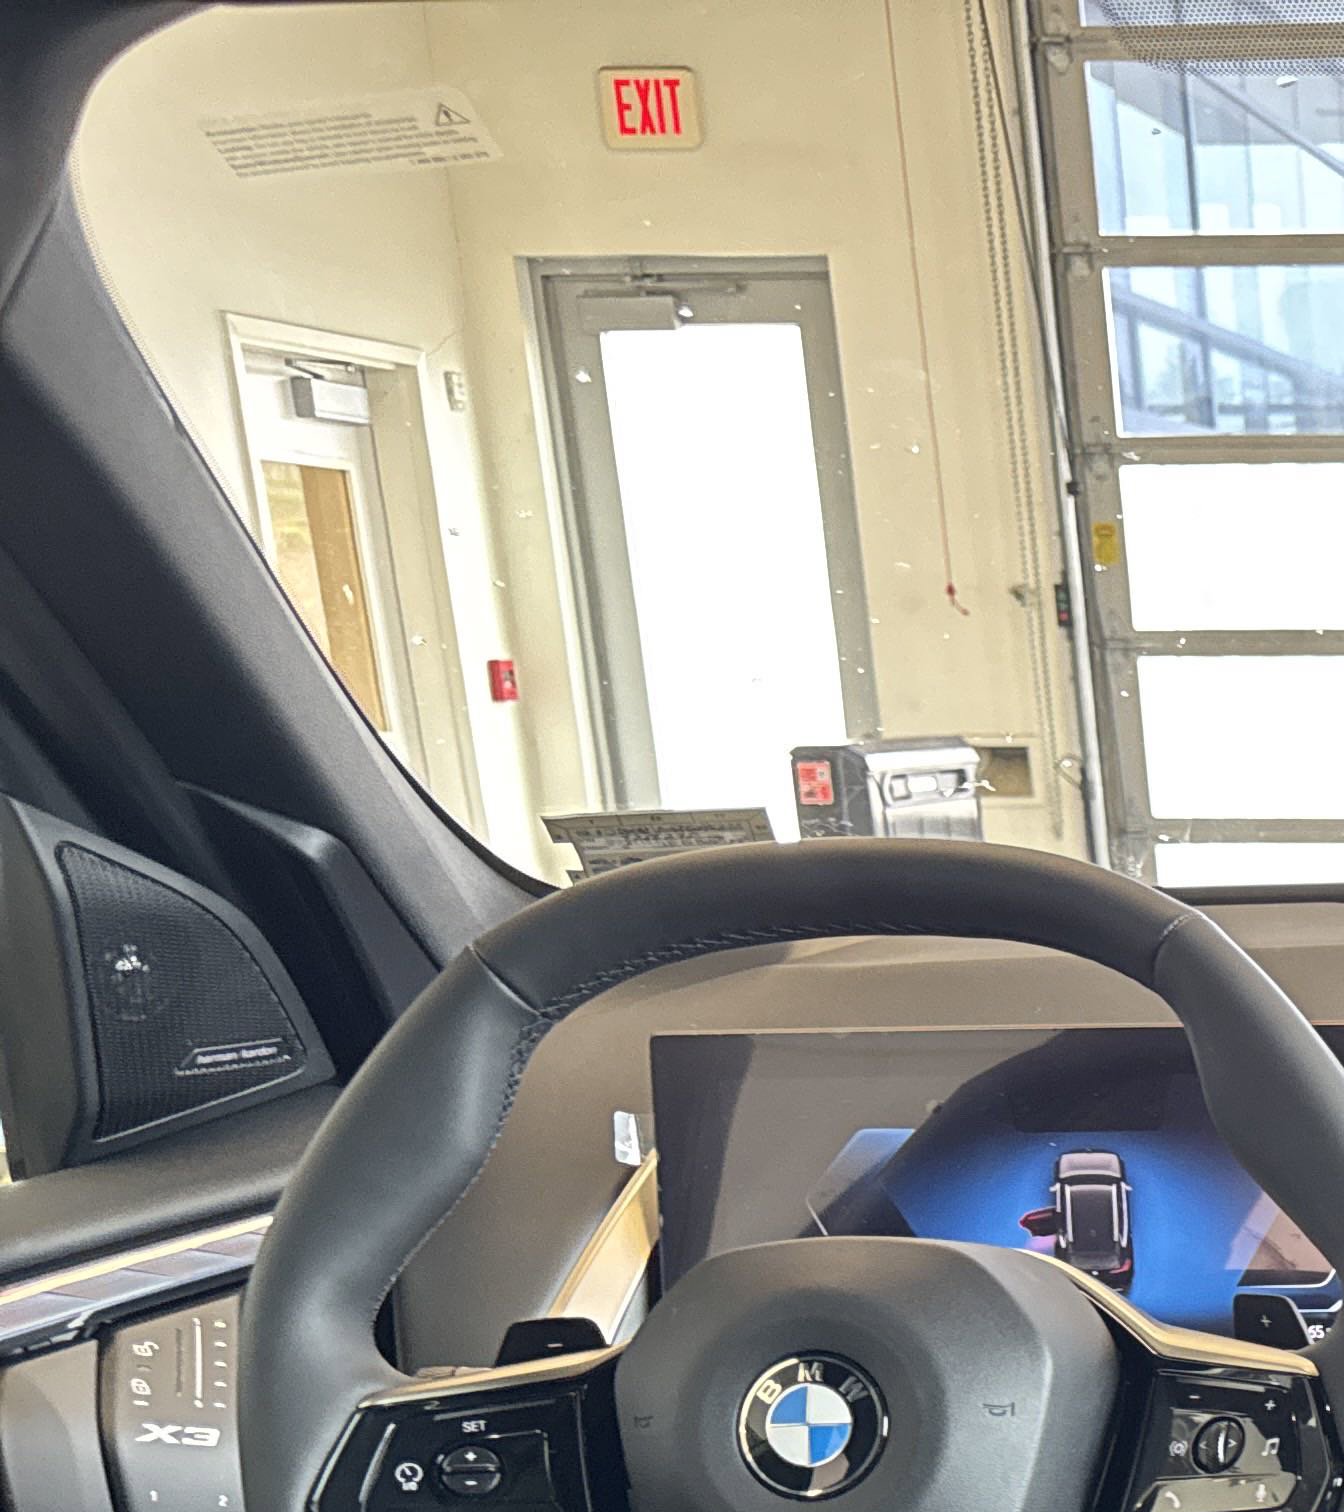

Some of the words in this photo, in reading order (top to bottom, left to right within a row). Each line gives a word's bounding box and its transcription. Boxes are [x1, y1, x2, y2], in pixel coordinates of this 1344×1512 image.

[613, 79, 682, 135] EXIT
[757, 1361, 870, 1405] BMW
[135, 1423, 220, 1447] X3
[461, 1419, 487, 1433] SET
